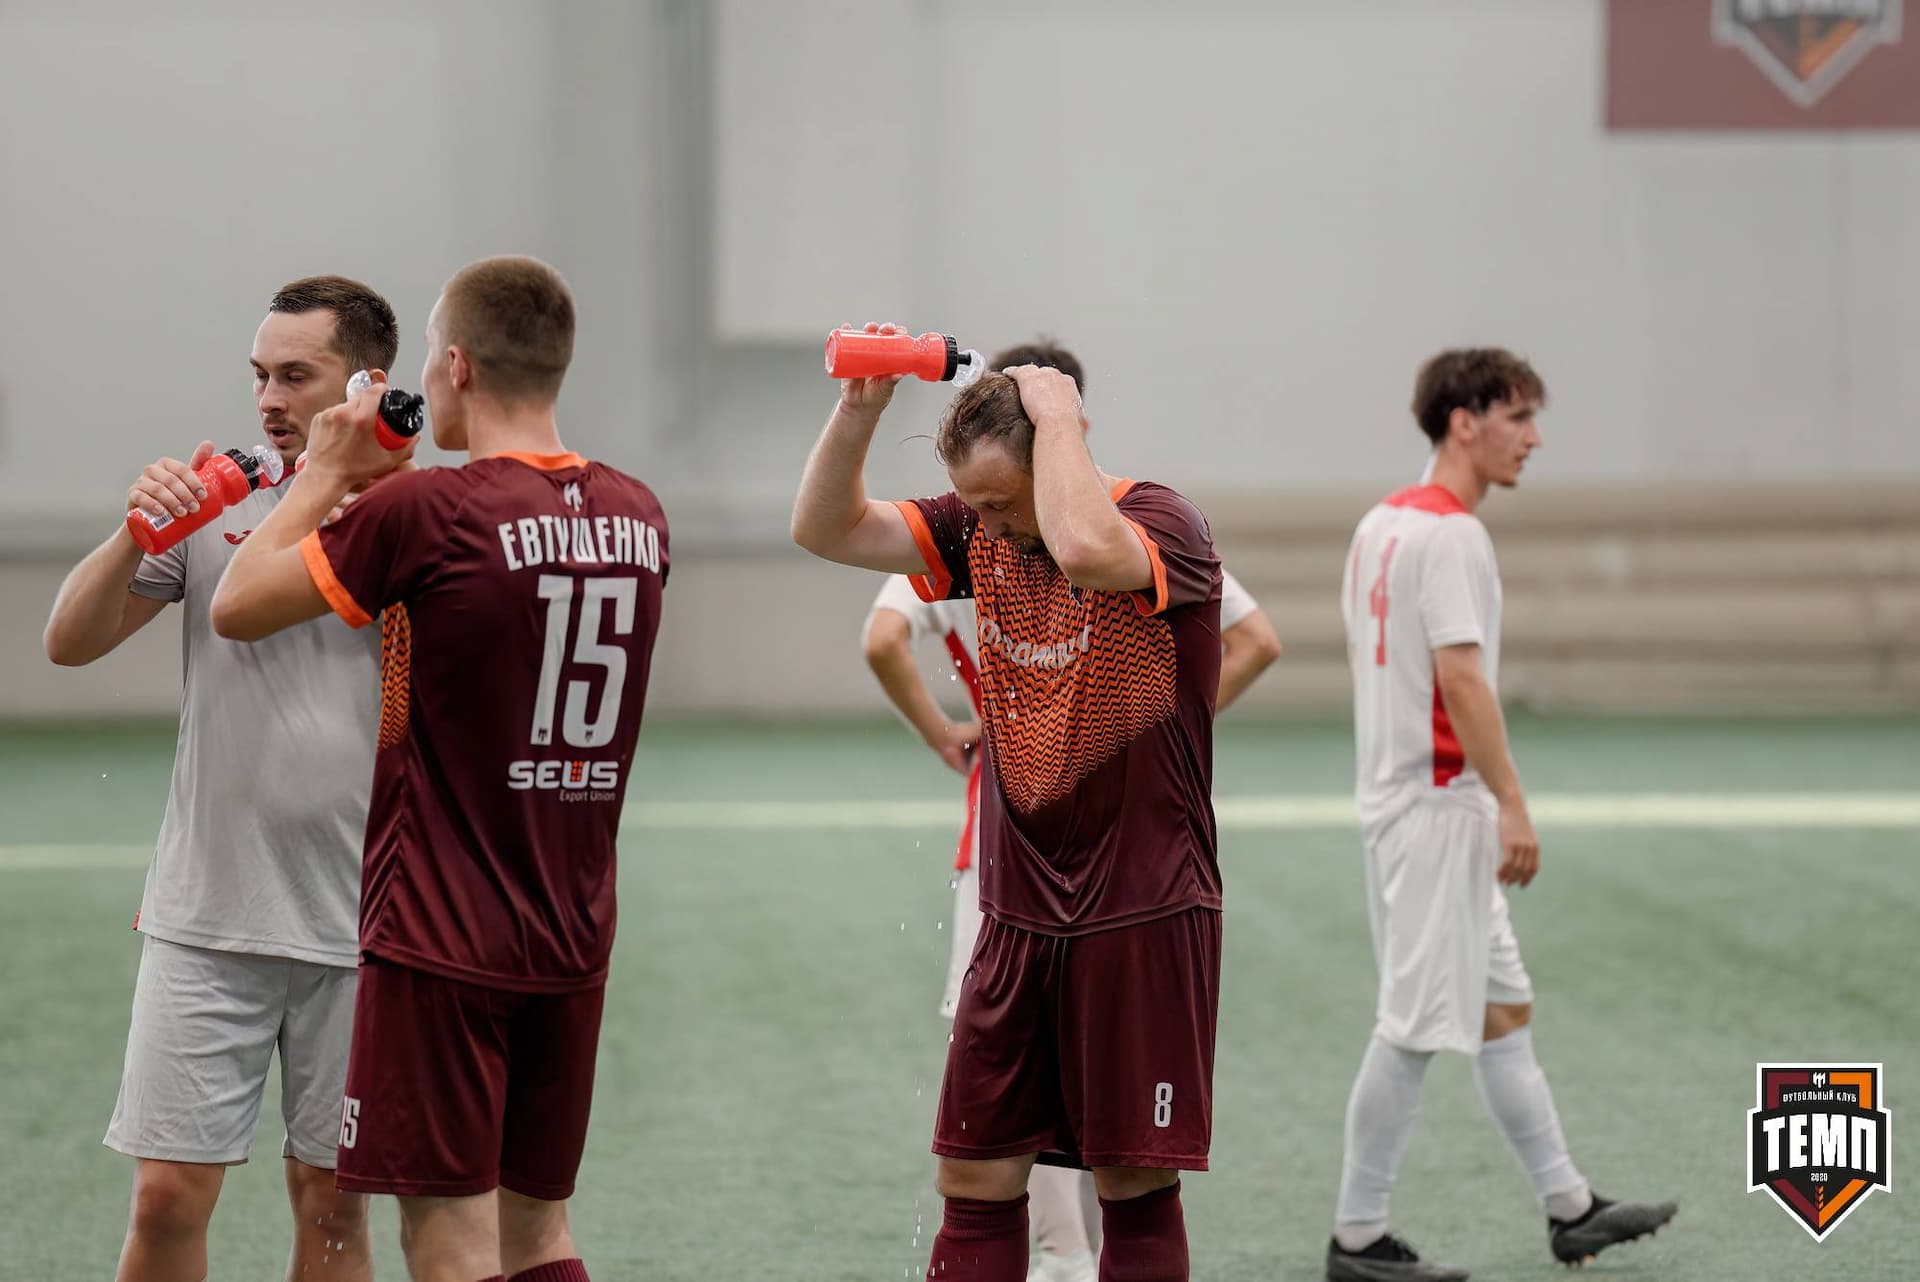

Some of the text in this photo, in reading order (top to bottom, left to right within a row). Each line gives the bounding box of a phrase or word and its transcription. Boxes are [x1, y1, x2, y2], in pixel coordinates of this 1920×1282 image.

[498, 515, 661, 574] ЕВТУШЕНКО
[531, 575, 638, 747] 15
[507, 760, 619, 789] SEUS
[559, 790, 616, 803] Export Union
[1154, 1082, 1173, 1127] 8
